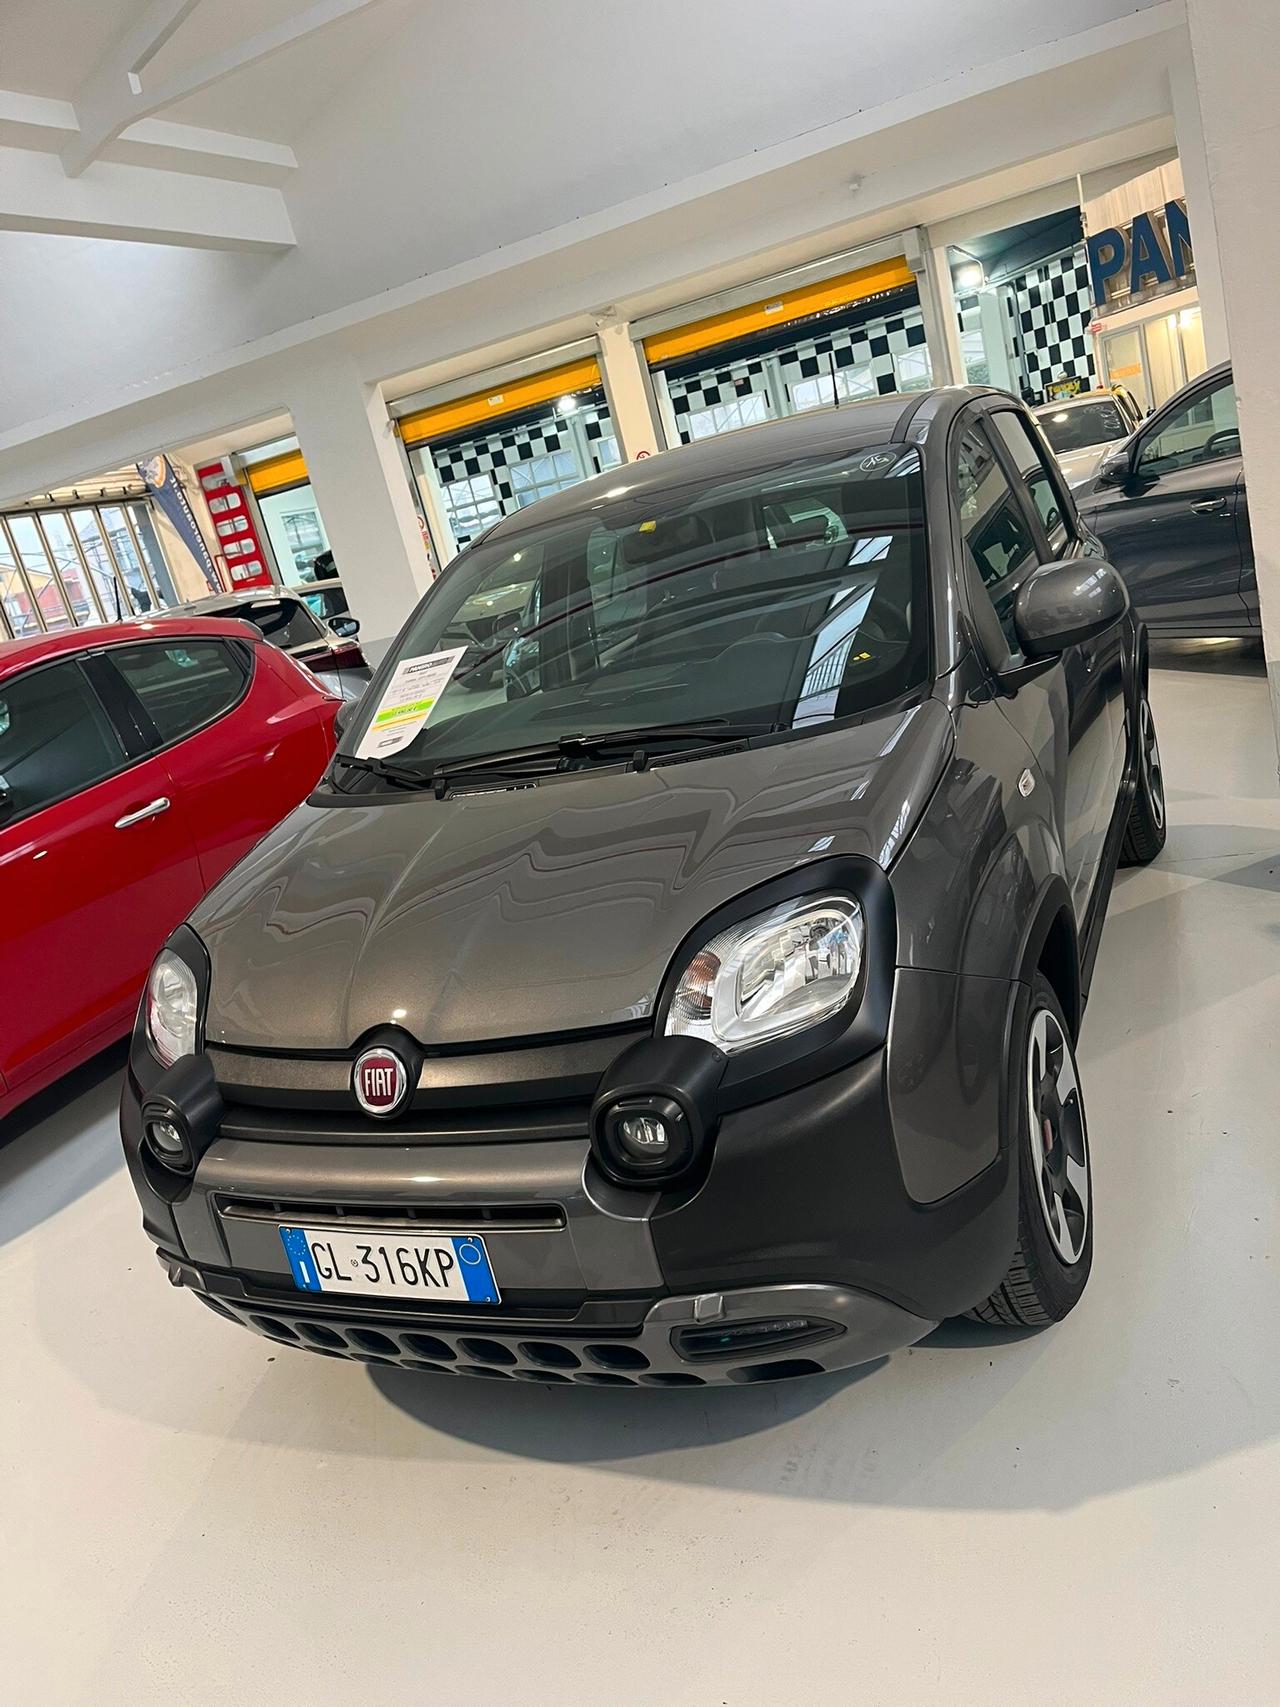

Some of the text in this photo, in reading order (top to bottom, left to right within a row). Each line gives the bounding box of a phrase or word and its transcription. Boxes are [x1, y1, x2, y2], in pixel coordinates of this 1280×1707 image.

[364, 1068, 394, 1096] FIAT
[311, 1242, 454, 1288] GL 316KP
